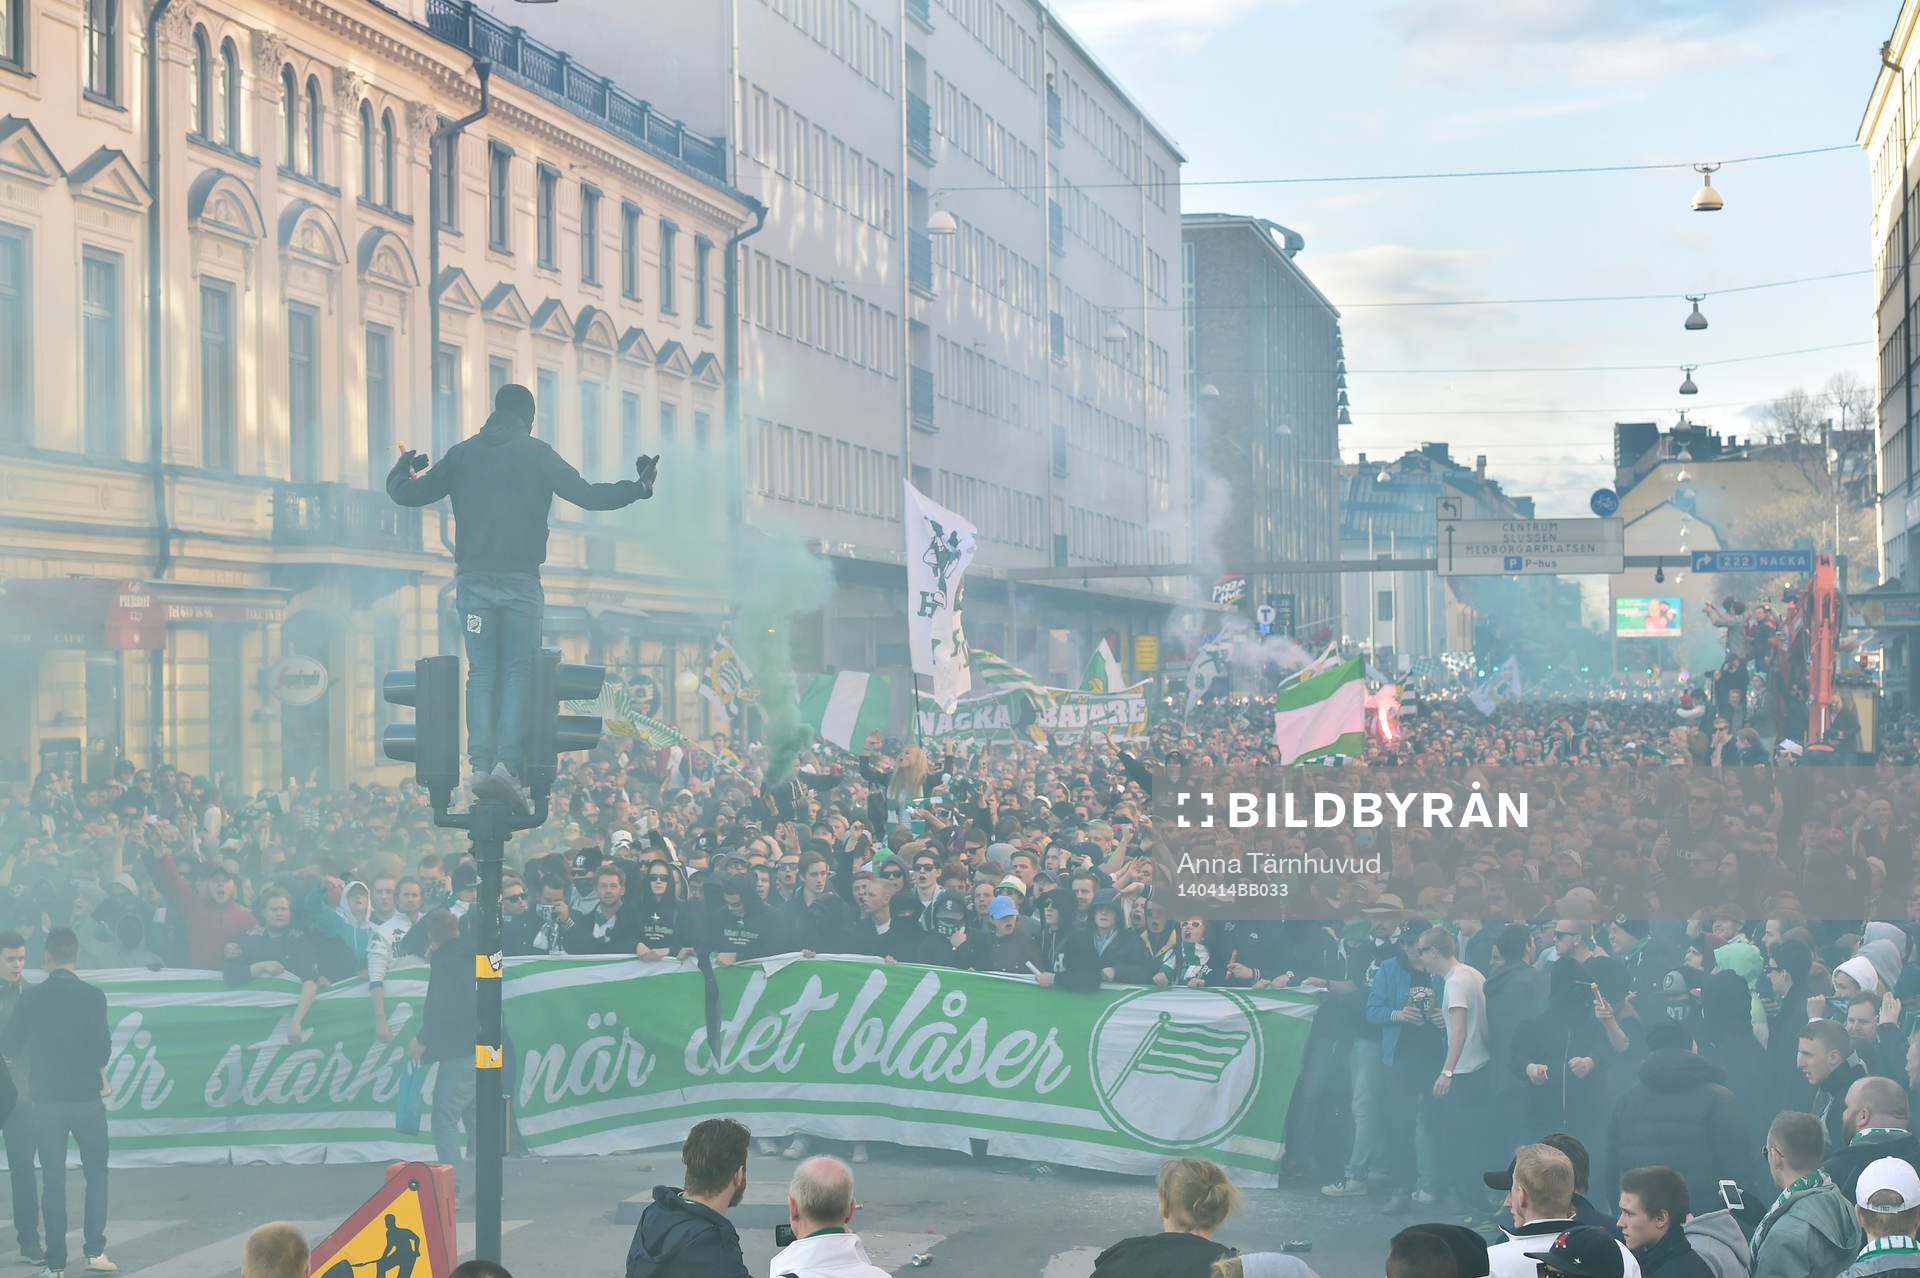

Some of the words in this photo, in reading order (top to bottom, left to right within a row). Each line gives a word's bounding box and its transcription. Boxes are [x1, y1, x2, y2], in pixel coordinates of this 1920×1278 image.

[1502, 522, 1558, 532] CENTRUM
[1503, 533, 1557, 543] SLUSSEN
[1465, 543, 1595, 555] MEDBORGARPLATSEN
[1525, 558, 1557, 568] P-hus
[1723, 553, 1750, 567] 222
[1759, 552, 1806, 566] NACKA
[914, 704, 1012, 736] NACKA
[520, 1011, 656, 1107] när
[684, 970, 840, 1076] det
[832, 968, 1071, 1094] blåser
